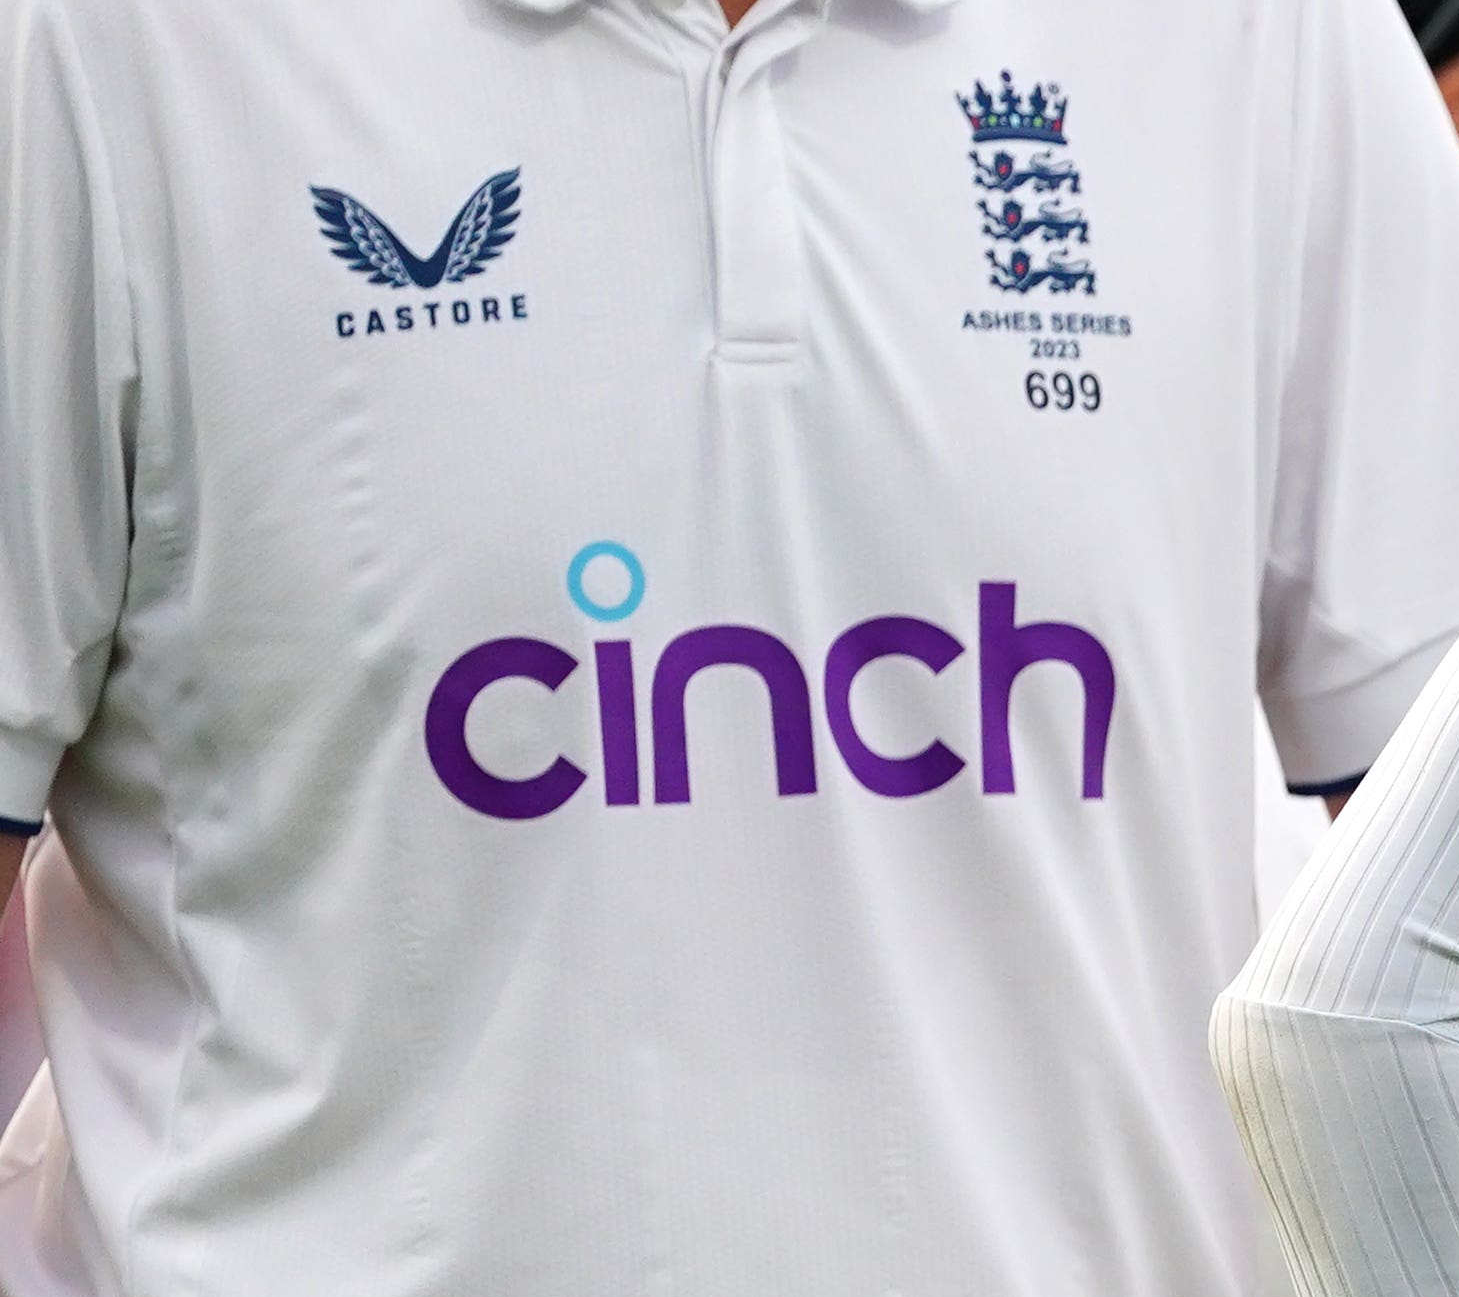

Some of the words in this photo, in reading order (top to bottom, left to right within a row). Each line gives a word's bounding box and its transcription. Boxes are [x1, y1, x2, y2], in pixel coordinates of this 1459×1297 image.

[336, 295, 528, 338] CASTORE
[962, 310, 1043, 332] ASHES
[1050, 312, 1132, 337] SERIES
[1029, 339, 1081, 359] 2023
[1025, 370, 1101, 412] 699
[425, 540, 1115, 820] cinch
